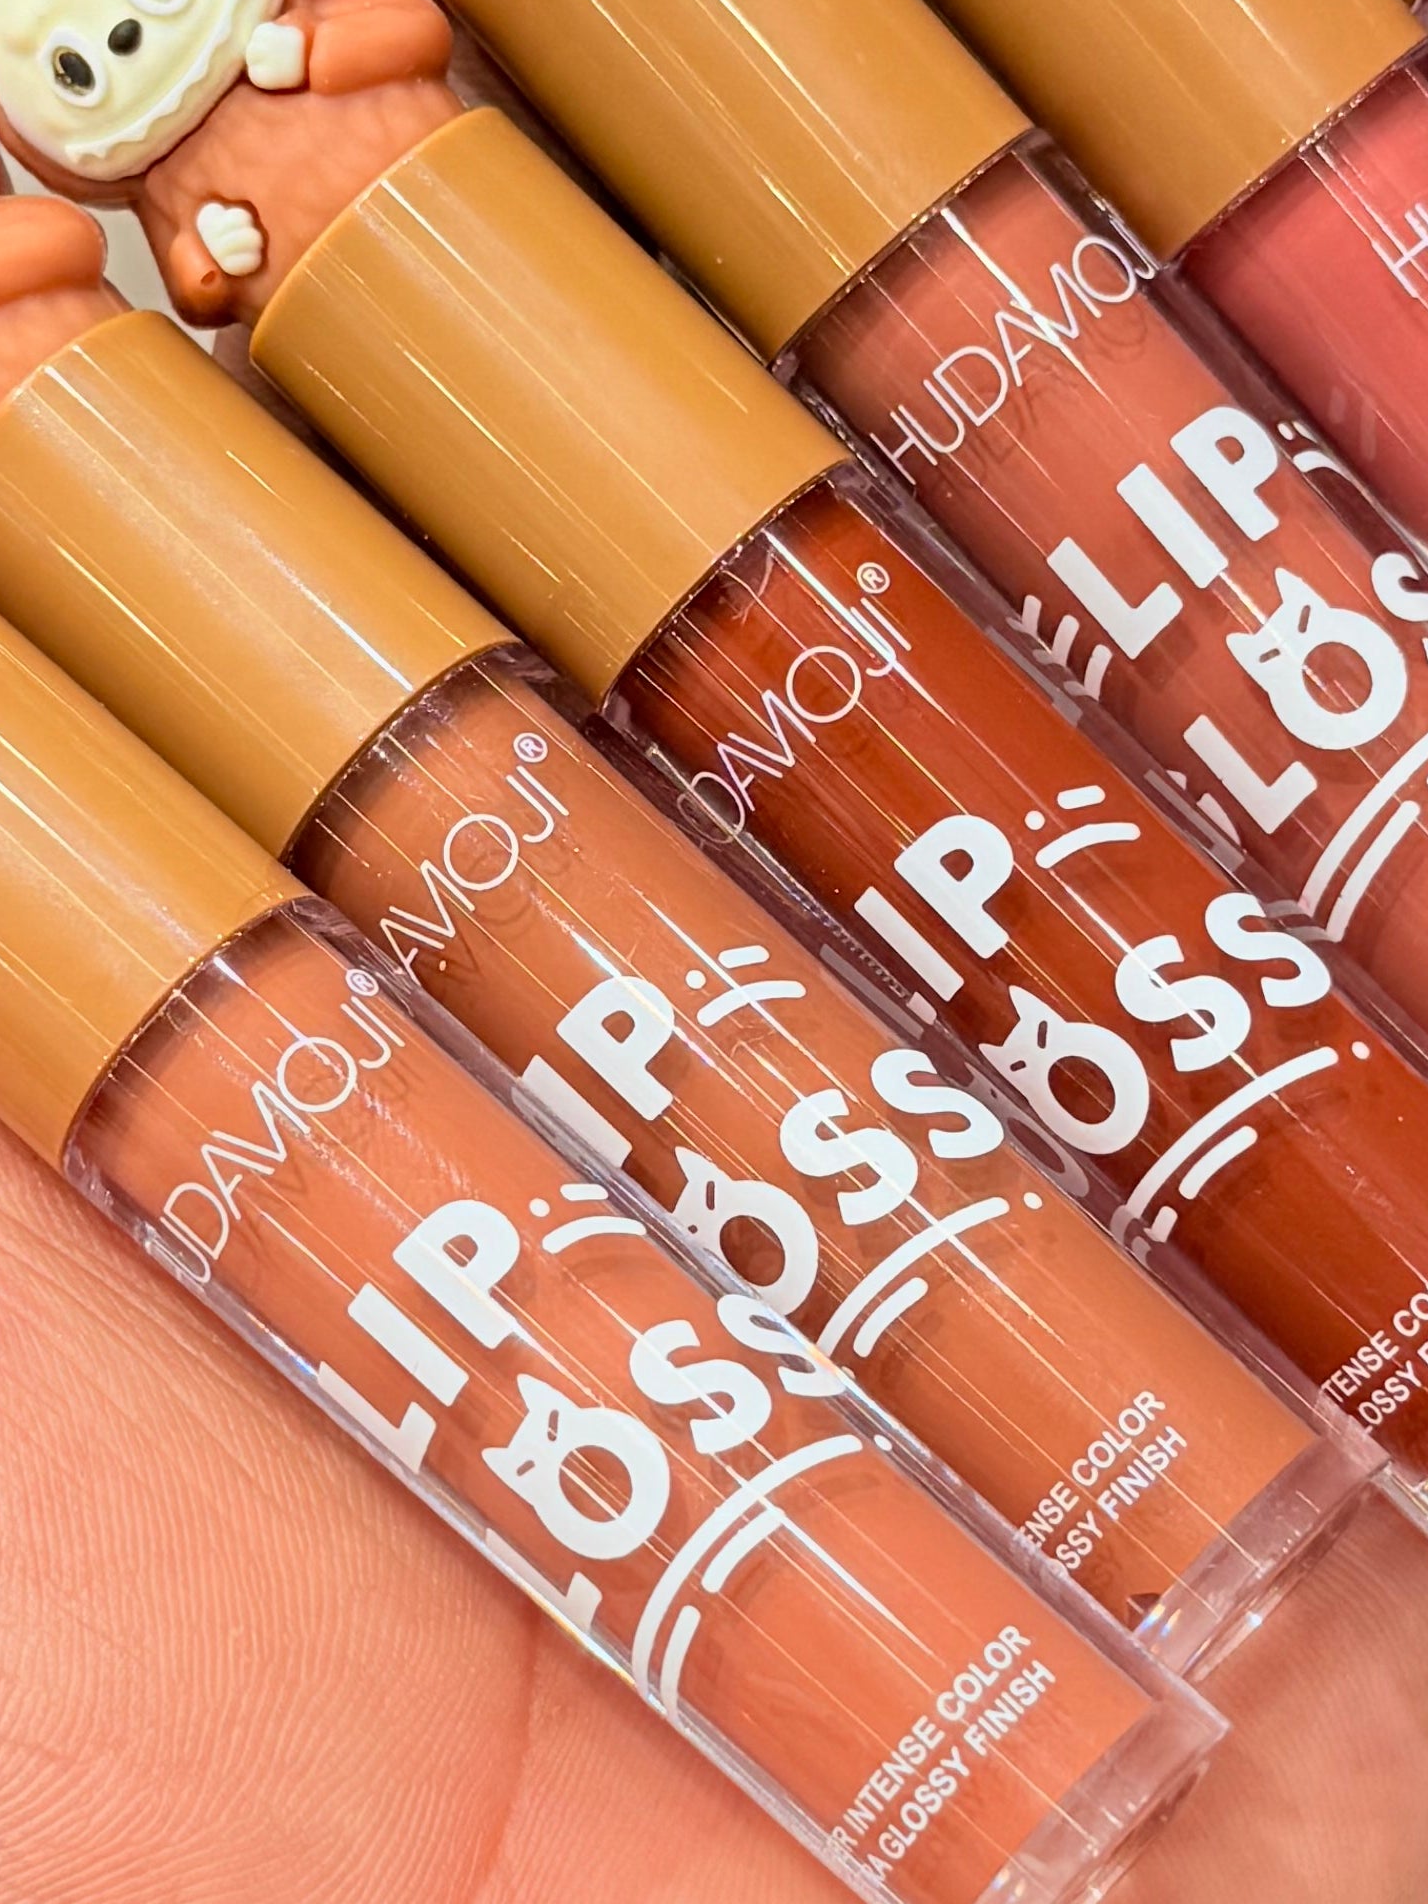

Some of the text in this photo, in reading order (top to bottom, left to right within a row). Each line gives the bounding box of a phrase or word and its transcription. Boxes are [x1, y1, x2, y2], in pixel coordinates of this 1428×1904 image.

[1045, 406, 1281, 661] LIP
[317, 1198, 521, 1474] LIP
[1358, 1359, 1423, 1433] OSSY
[1070, 1390, 1167, 1487] COLOR
[1096, 1425, 1188, 1522] FINISH
[842, 1624, 1032, 1836] INTENSE COLOR
[877, 1659, 1057, 1861] GLOSSY FINISH
